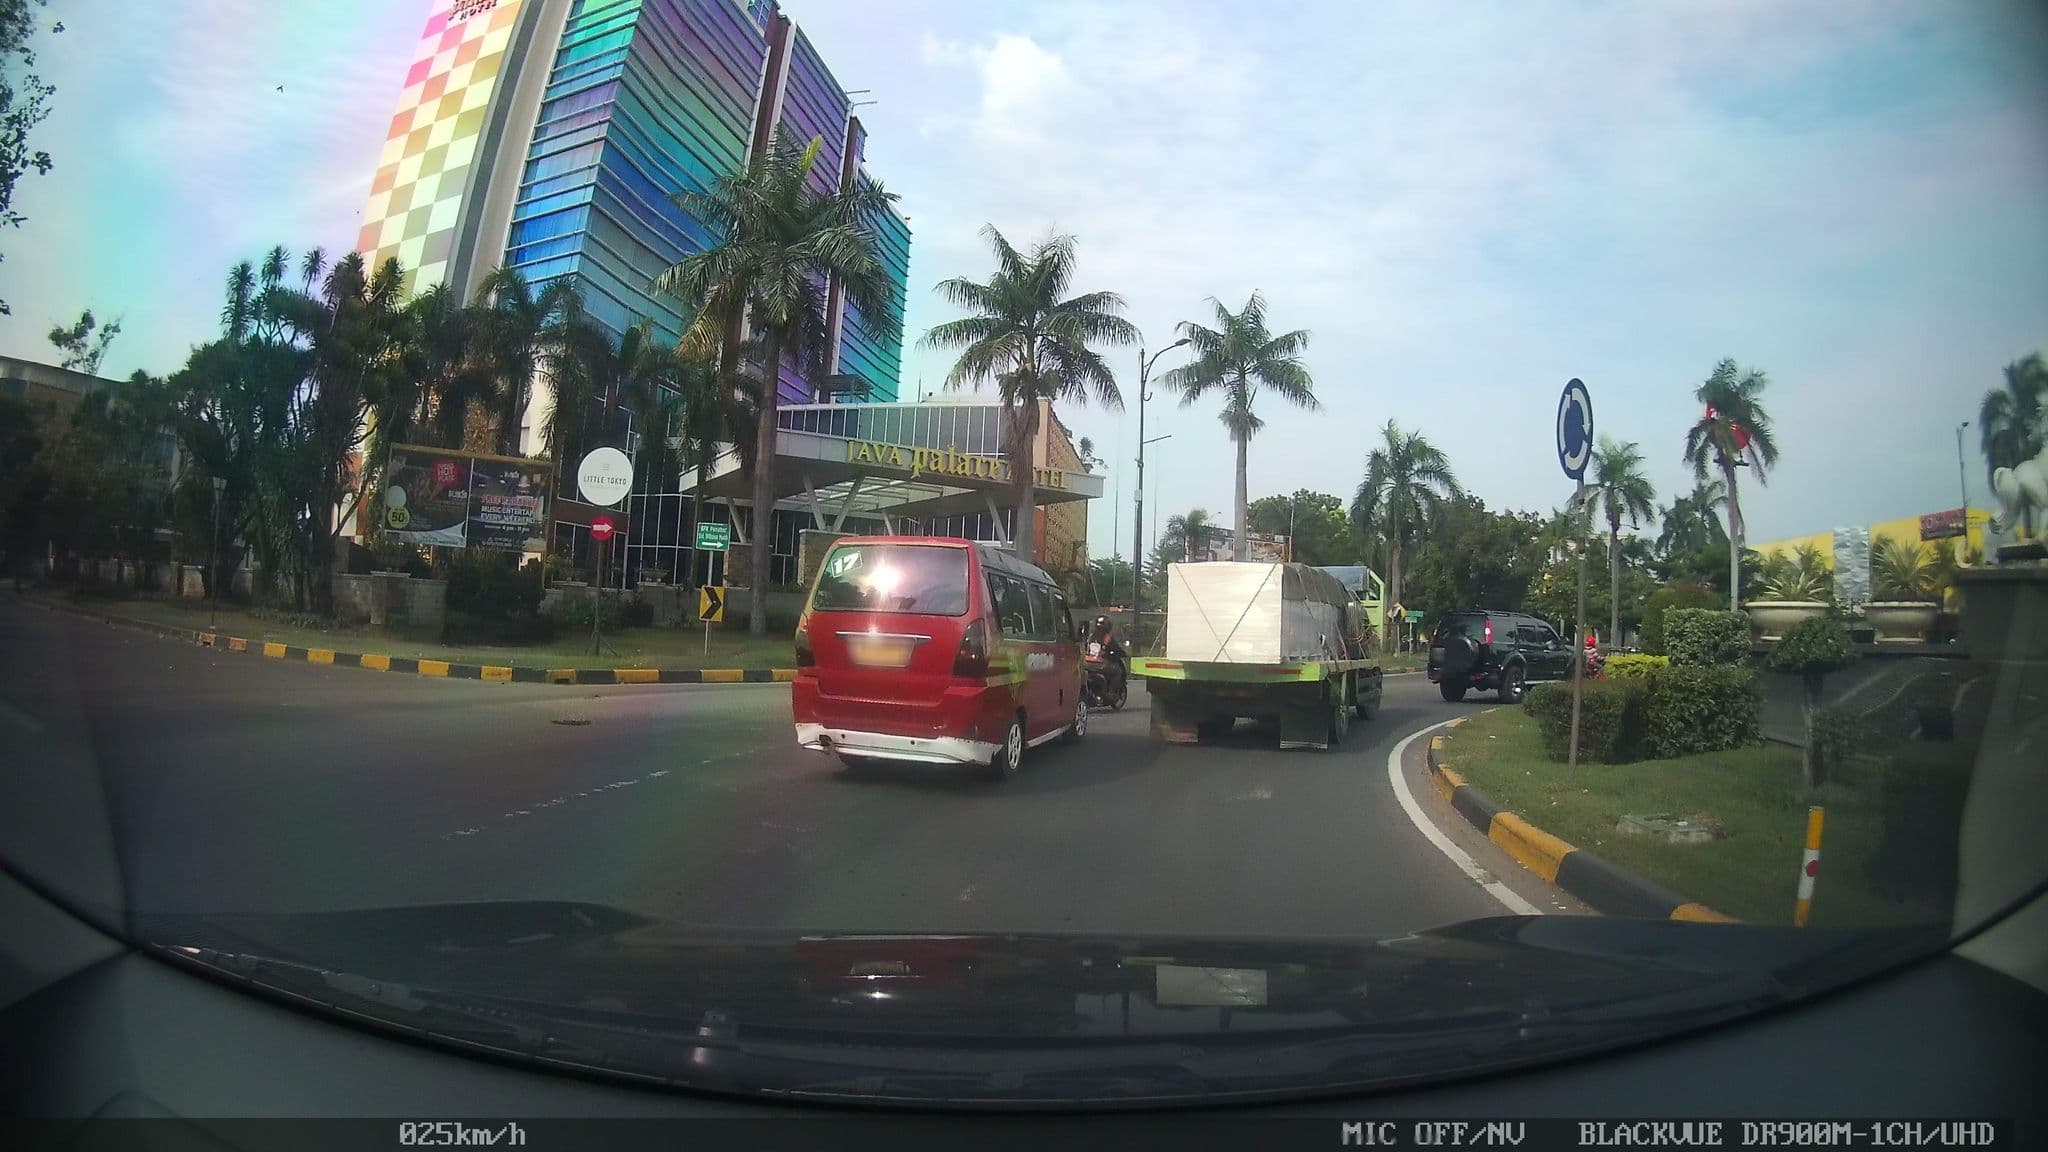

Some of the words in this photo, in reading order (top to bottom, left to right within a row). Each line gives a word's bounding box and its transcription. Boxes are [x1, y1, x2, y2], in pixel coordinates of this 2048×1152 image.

[848, 440, 903, 466] JAVA
[583, 475, 605, 484] LITTLE
[607, 477, 628, 486] TOKYO
